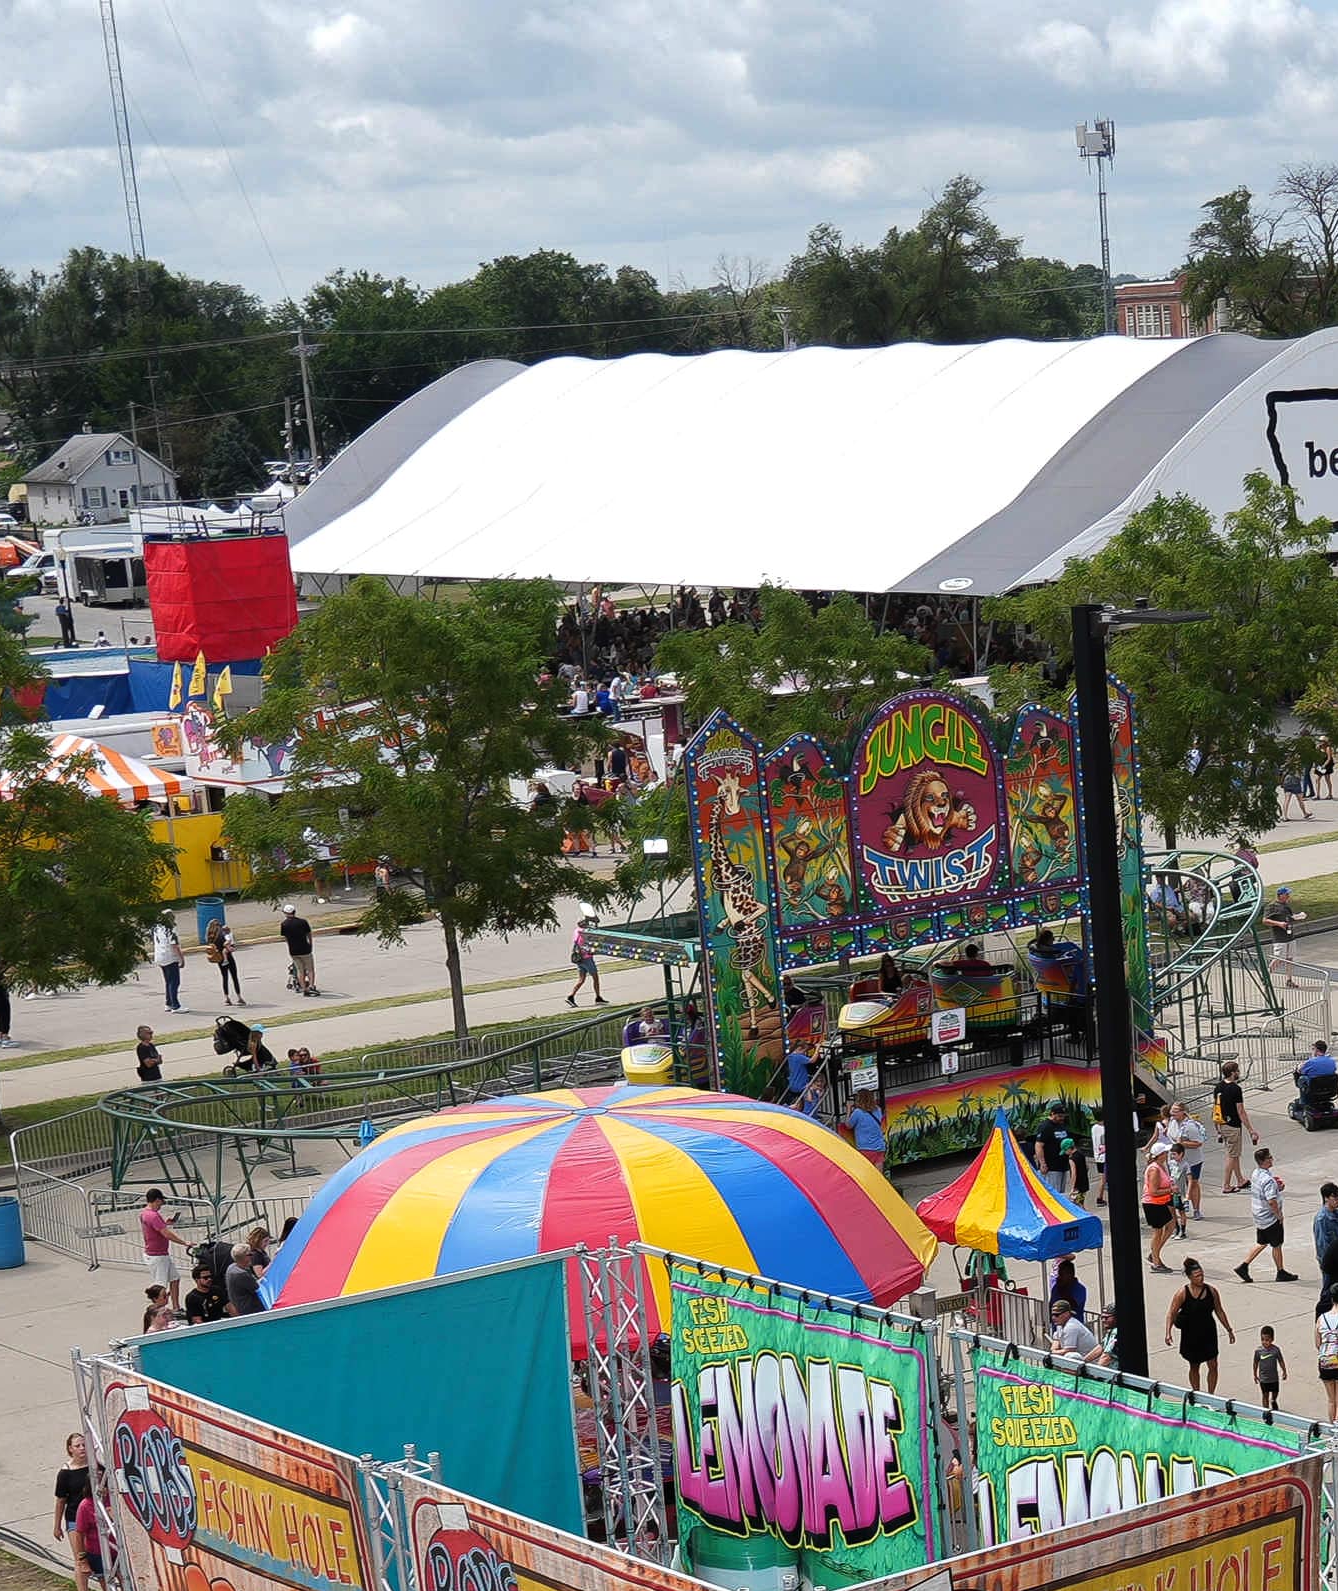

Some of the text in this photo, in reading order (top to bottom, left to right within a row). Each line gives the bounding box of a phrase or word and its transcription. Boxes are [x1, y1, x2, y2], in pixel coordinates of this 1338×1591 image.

[859, 703, 992, 797] JUNGLE
[862, 822, 997, 904] TWIST
[114, 1407, 354, 1585] BOB'S FISHIN' HOLE
[671, 1348, 919, 1553] LEMONADE
